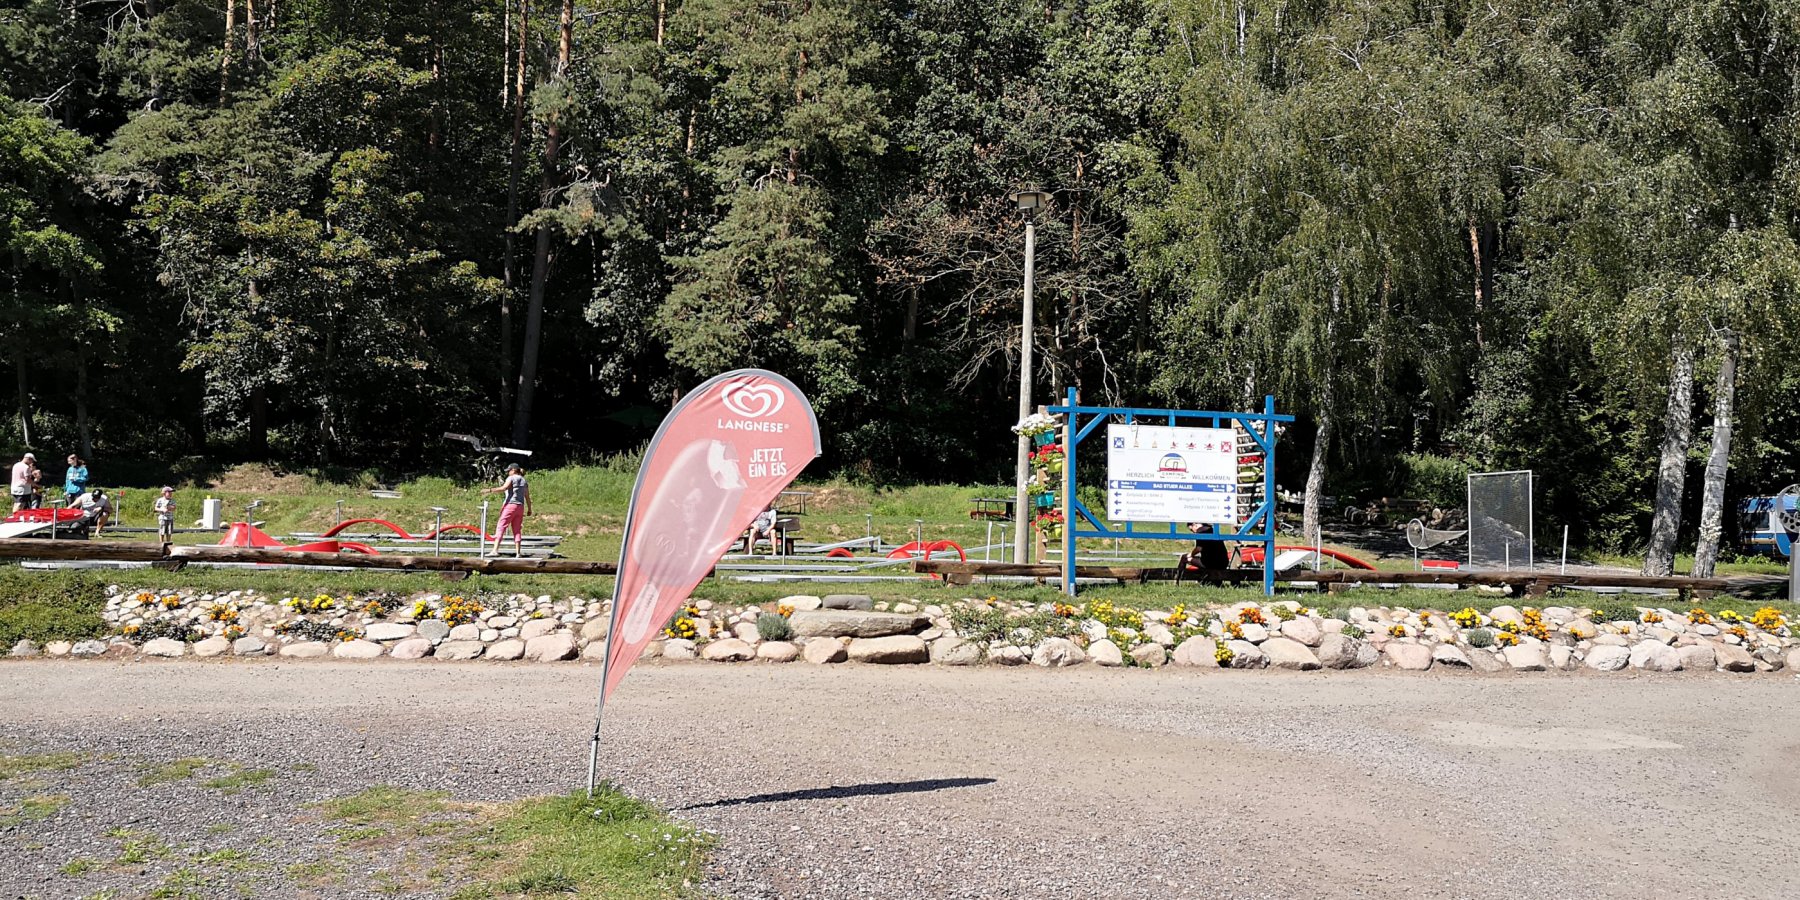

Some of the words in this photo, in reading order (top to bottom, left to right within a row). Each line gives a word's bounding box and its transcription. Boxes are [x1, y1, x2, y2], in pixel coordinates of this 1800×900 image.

[718, 418, 783, 433] LANGNESE
[750, 448, 784, 462] JETZT
[748, 463, 767, 477] EIN
[771, 462, 787, 476] EIS
